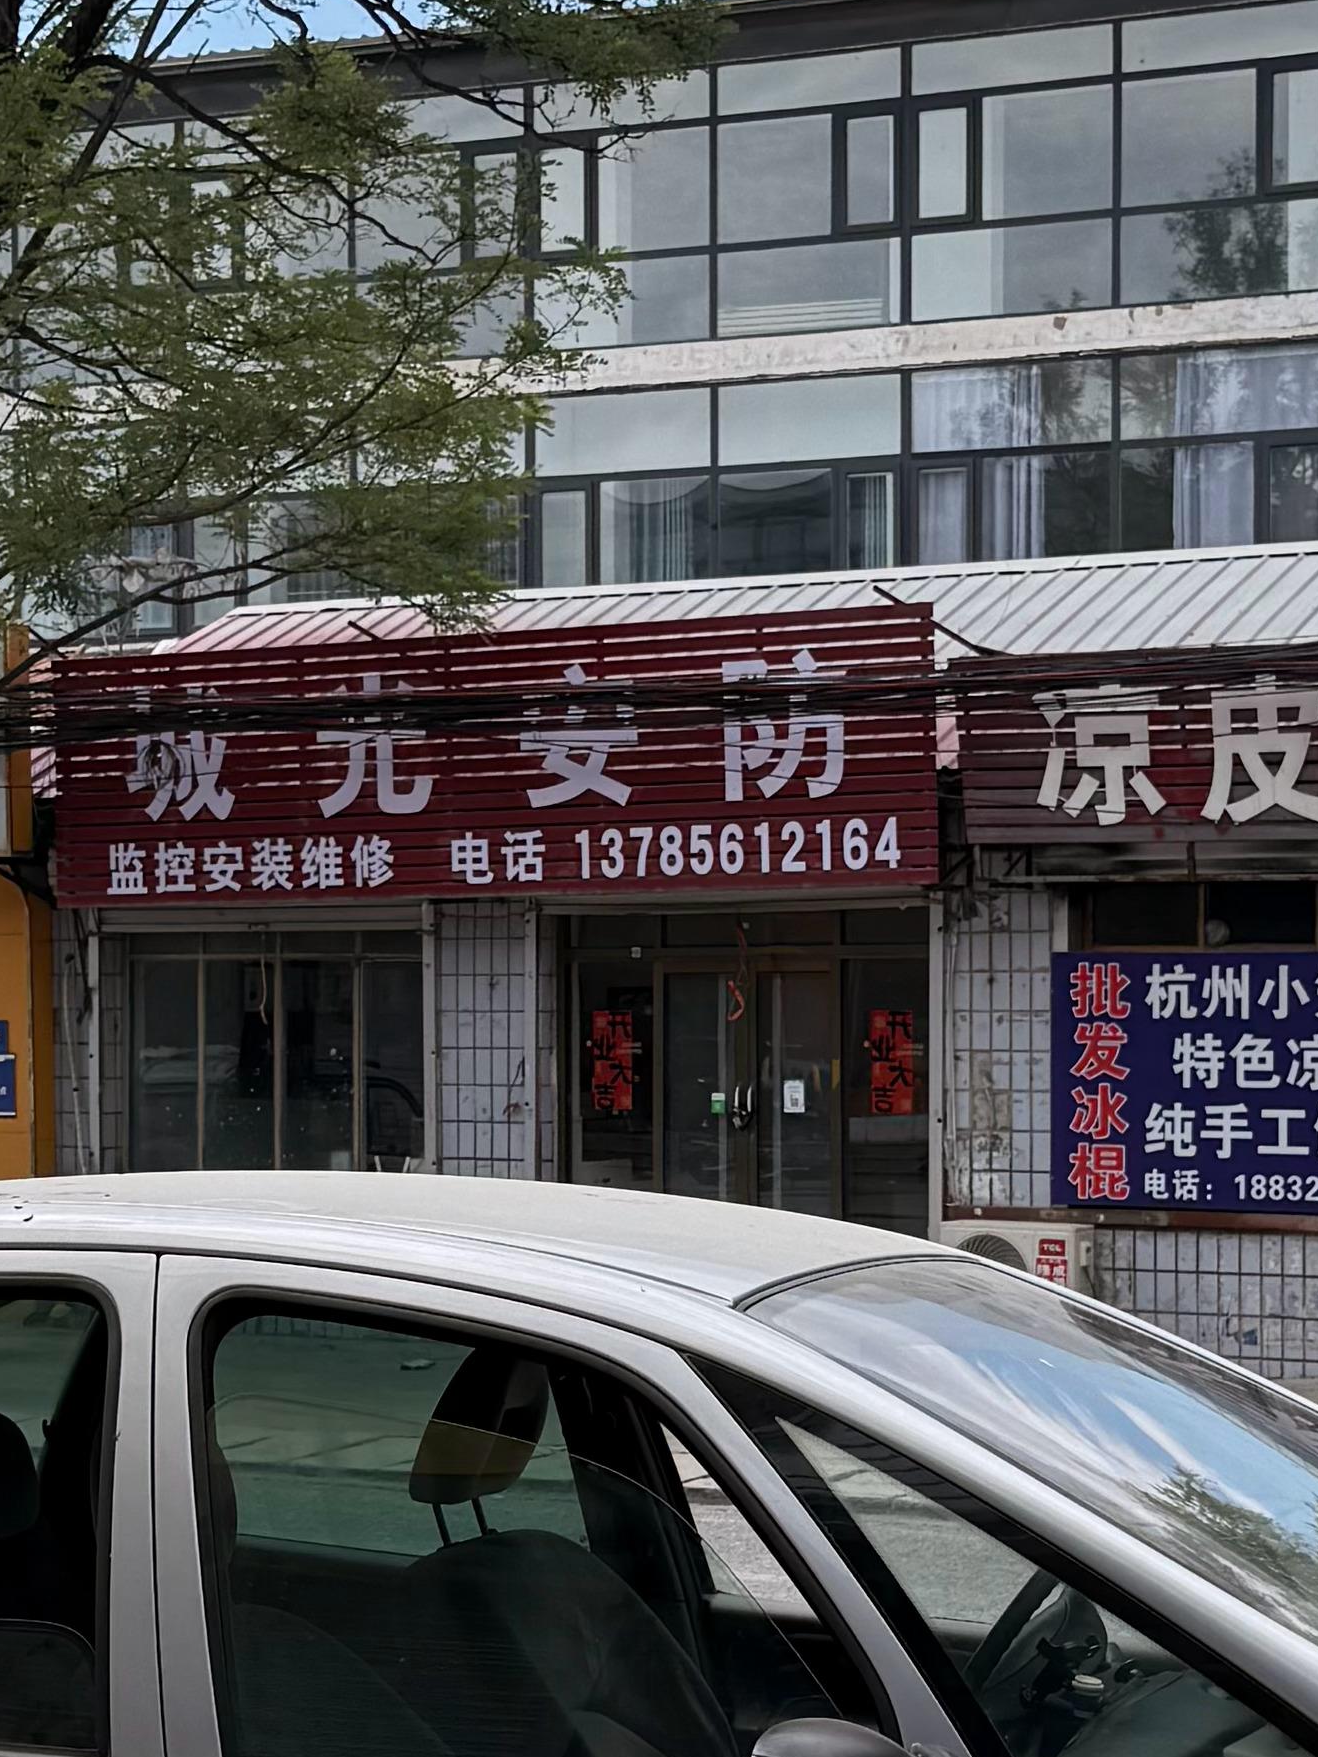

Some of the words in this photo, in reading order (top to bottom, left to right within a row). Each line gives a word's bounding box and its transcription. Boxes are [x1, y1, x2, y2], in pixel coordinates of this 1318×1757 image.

[107, 835, 395, 895] 监控安装维修
[451, 830, 546, 885] 电话
[575, 817, 901, 879] 13785612164
[1068, 962, 1131, 1201] 批发冰棍
[1042, 1244, 1063, 1253] TCL
